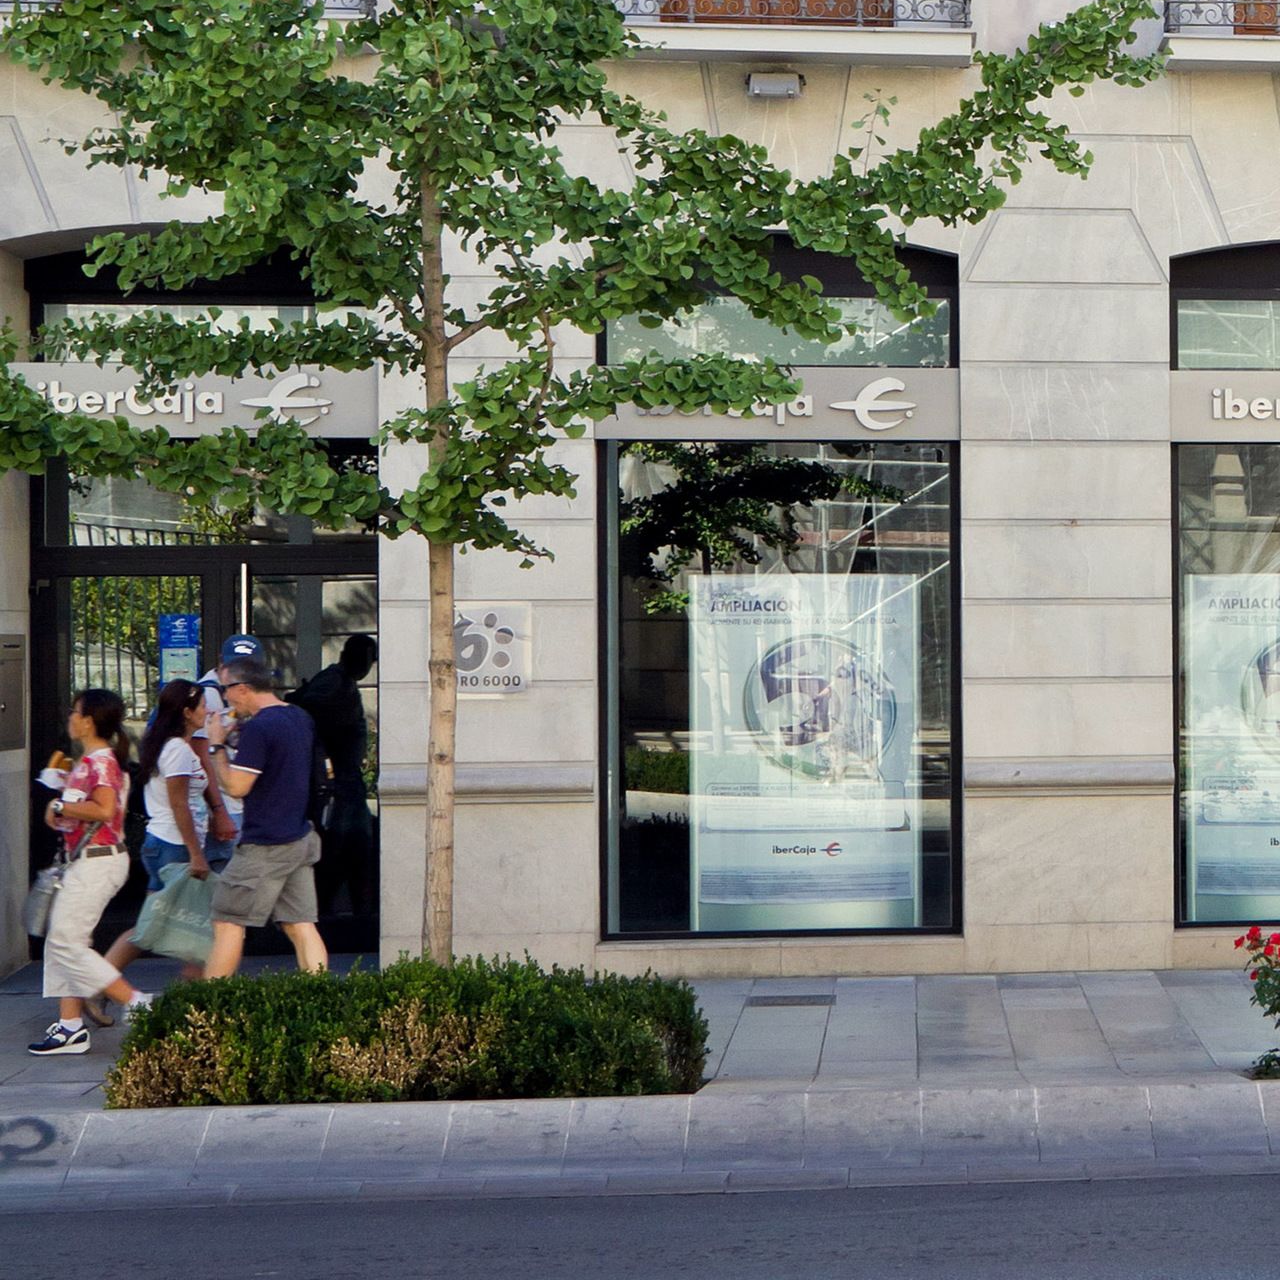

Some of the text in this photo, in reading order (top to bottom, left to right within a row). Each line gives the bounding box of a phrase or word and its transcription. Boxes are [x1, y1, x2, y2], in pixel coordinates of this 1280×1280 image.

[37, 381, 224, 423] iberCaja
[710, 596, 802, 612] AMPLIACIÓN
[457, 675, 521, 687] RO 6000
[772, 844, 816, 855] iberCaja
